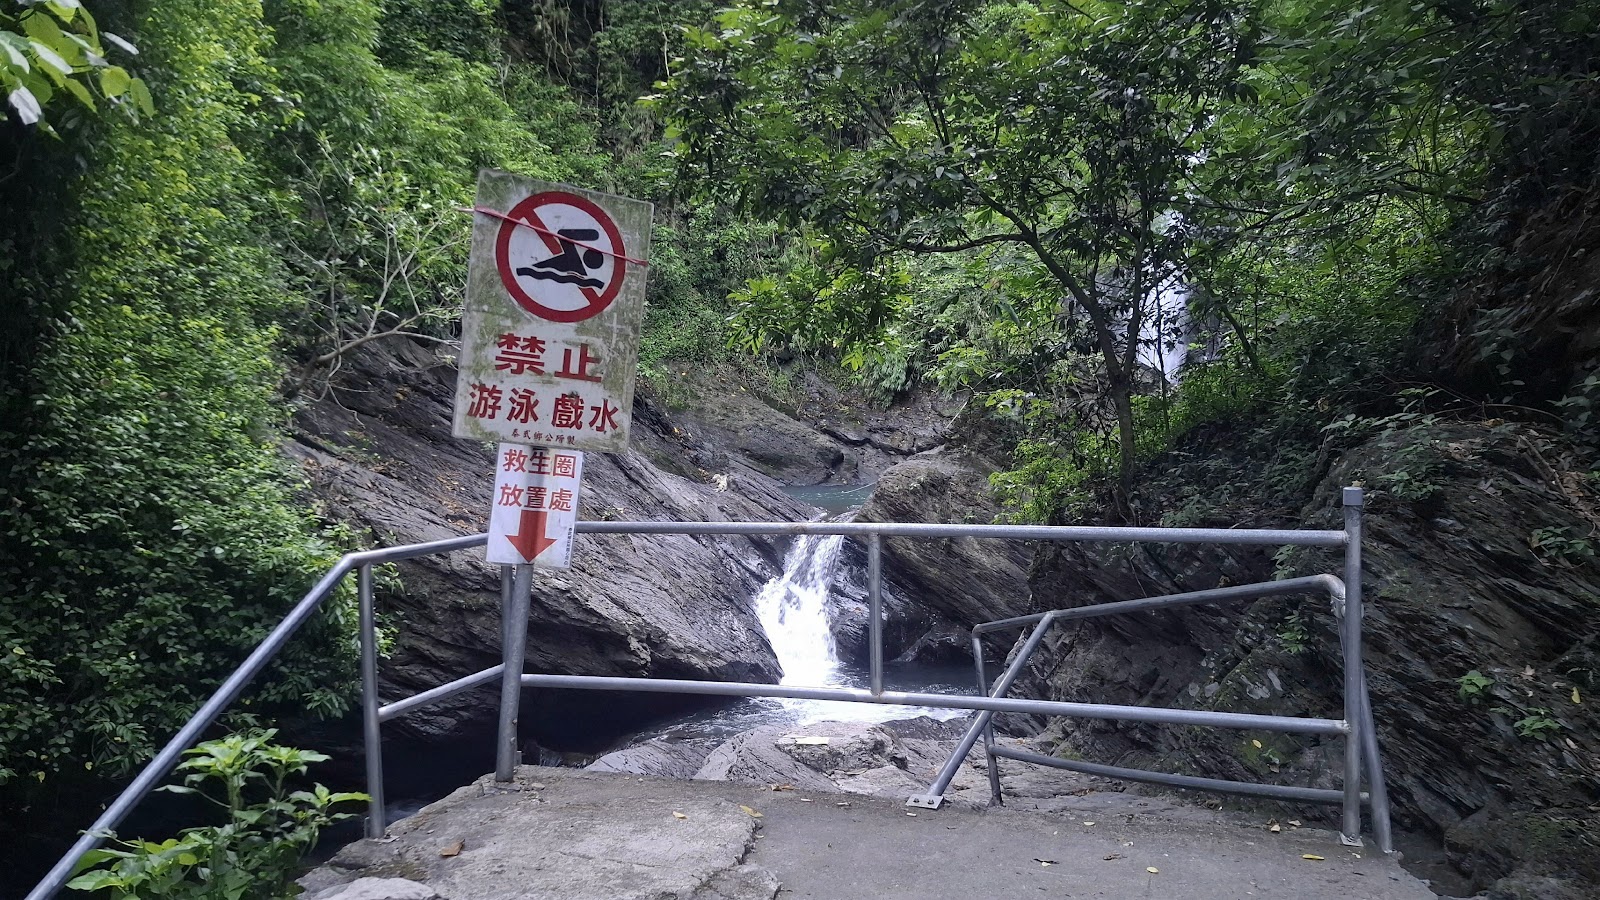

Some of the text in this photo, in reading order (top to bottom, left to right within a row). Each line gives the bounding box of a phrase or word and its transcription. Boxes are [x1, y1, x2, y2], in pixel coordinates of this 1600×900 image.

[495, 333, 603, 383] 禁止
[467, 383, 619, 433] 游泳戲水
[502, 448, 577, 478] 救生圈
[498, 483, 573, 512] 放置處
